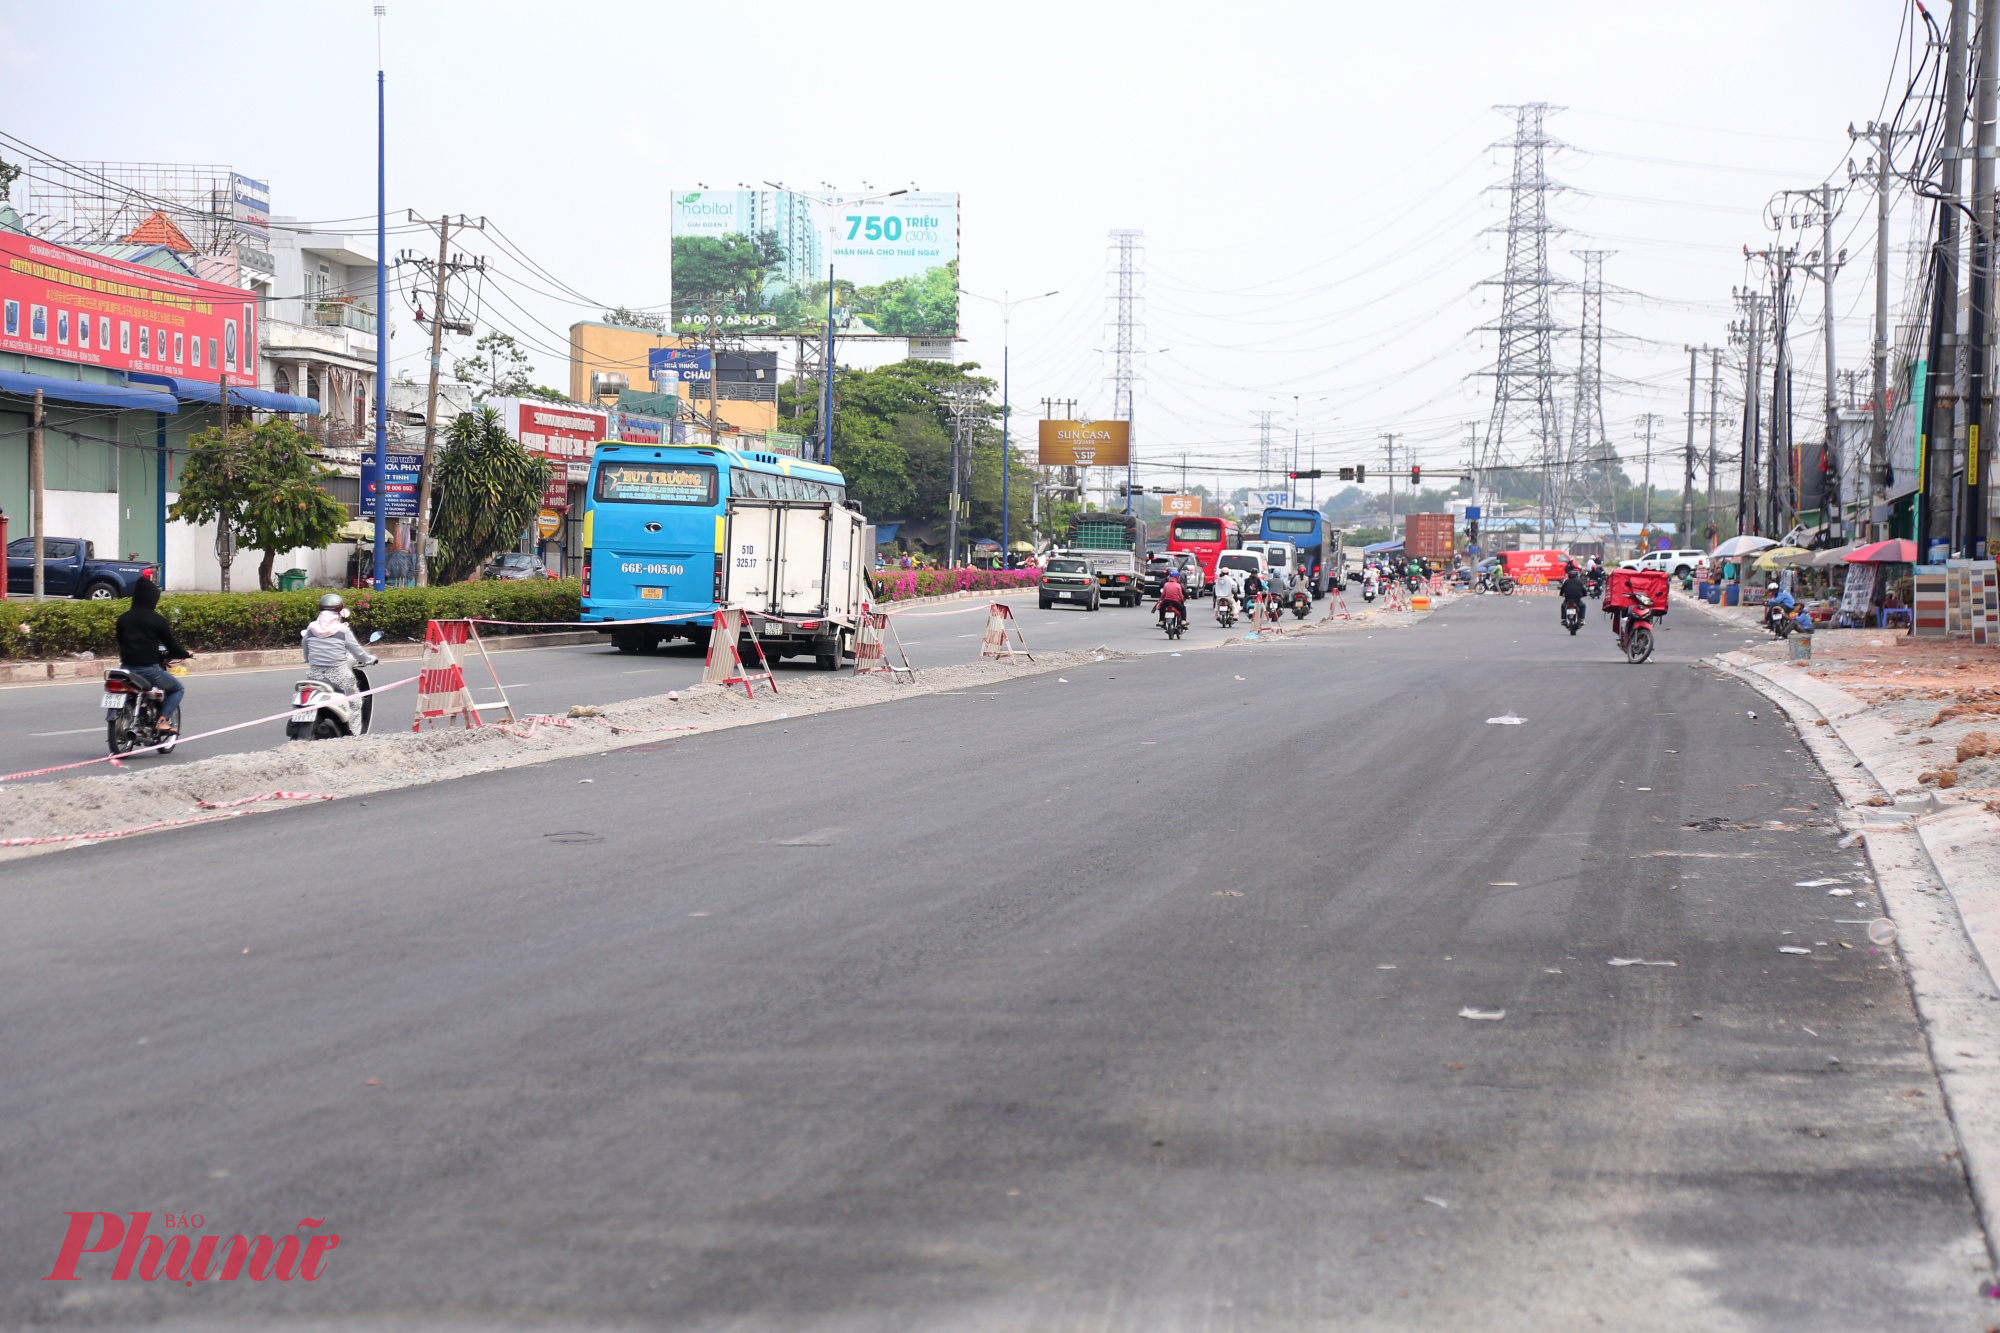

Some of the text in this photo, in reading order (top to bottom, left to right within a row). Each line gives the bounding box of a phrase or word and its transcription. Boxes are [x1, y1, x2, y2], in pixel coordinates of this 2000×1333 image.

[682, 195, 733, 215] habitat
[846, 215, 902, 241] 750
[905, 214, 939, 231] TRIỆU
[905, 231, 938, 243] (30%)
[833, 247, 855, 258] NHẬN
[857, 247, 874, 256] NHÀ
[897, 247, 915, 256] THUÊ
[917, 249, 940, 257] NGAY
[693, 314, 777, 326] 099 68 68 38
[683, 369, 711, 380] CHÂU
[1057, 430, 1111, 439] SUN CASA
[1073, 451, 1096, 459] VSIP
[622, 470, 650, 483] HUY
[555, 485, 566, 494] SINH
[741, 545, 754, 555] 51D
[736, 558, 757, 568] 325.17
[1529, 554, 1546, 562] SPX
[621, 563, 684, 576] 66E-005.00
